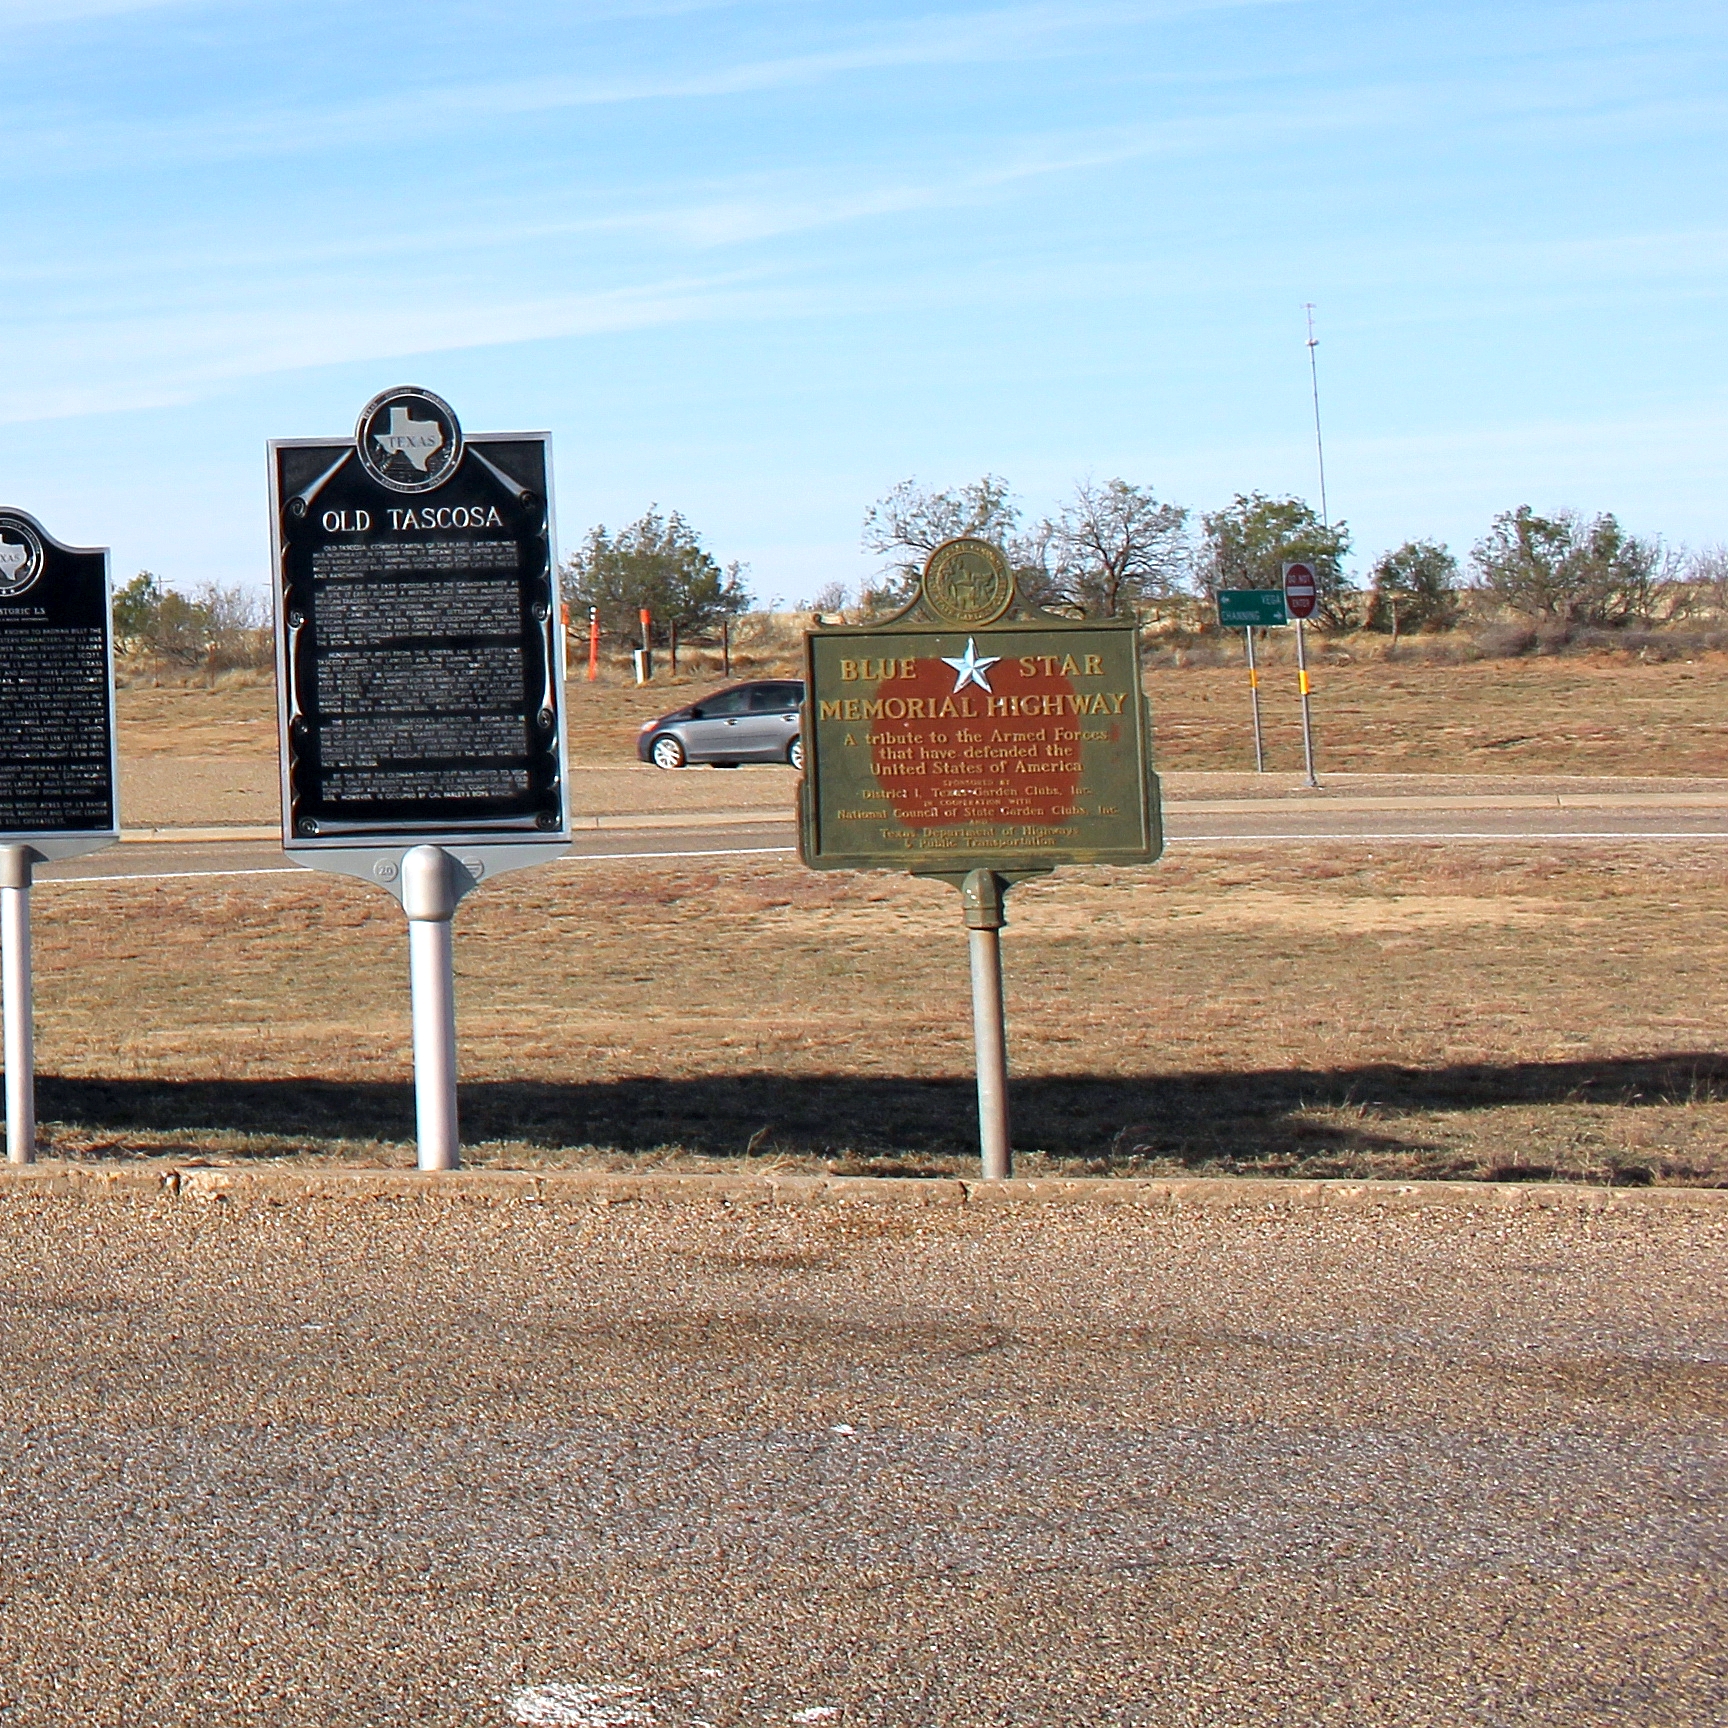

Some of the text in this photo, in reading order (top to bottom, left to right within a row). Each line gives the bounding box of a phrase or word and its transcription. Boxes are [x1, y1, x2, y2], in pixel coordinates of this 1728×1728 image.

[387, 434, 437, 449] TEXAS
[322, 505, 504, 532] OLD TASCOSA
[840, 653, 1105, 682] BLUE STAR
[819, 692, 1128, 722] MEMORIAL HIGHWAY
[844, 726, 1109, 746] A tribute to the Armed Forces
[879, 743, 1073, 760] that have defended the
[870, 760, 1084, 776] United States of America
[862, 789, 908, 800] District
[931, 787, 968, 798] Texas
[972, 787, 1018, 797] Garden
[837, 809, 888, 820] National
[892, 807, 940, 819] Council
[944, 807, 958, 818] of
[964, 807, 995, 817] State
[1000, 806, 1045, 816] Garden
[922, 826, 995, 838] Department
[1002, 826, 1016, 836] of
